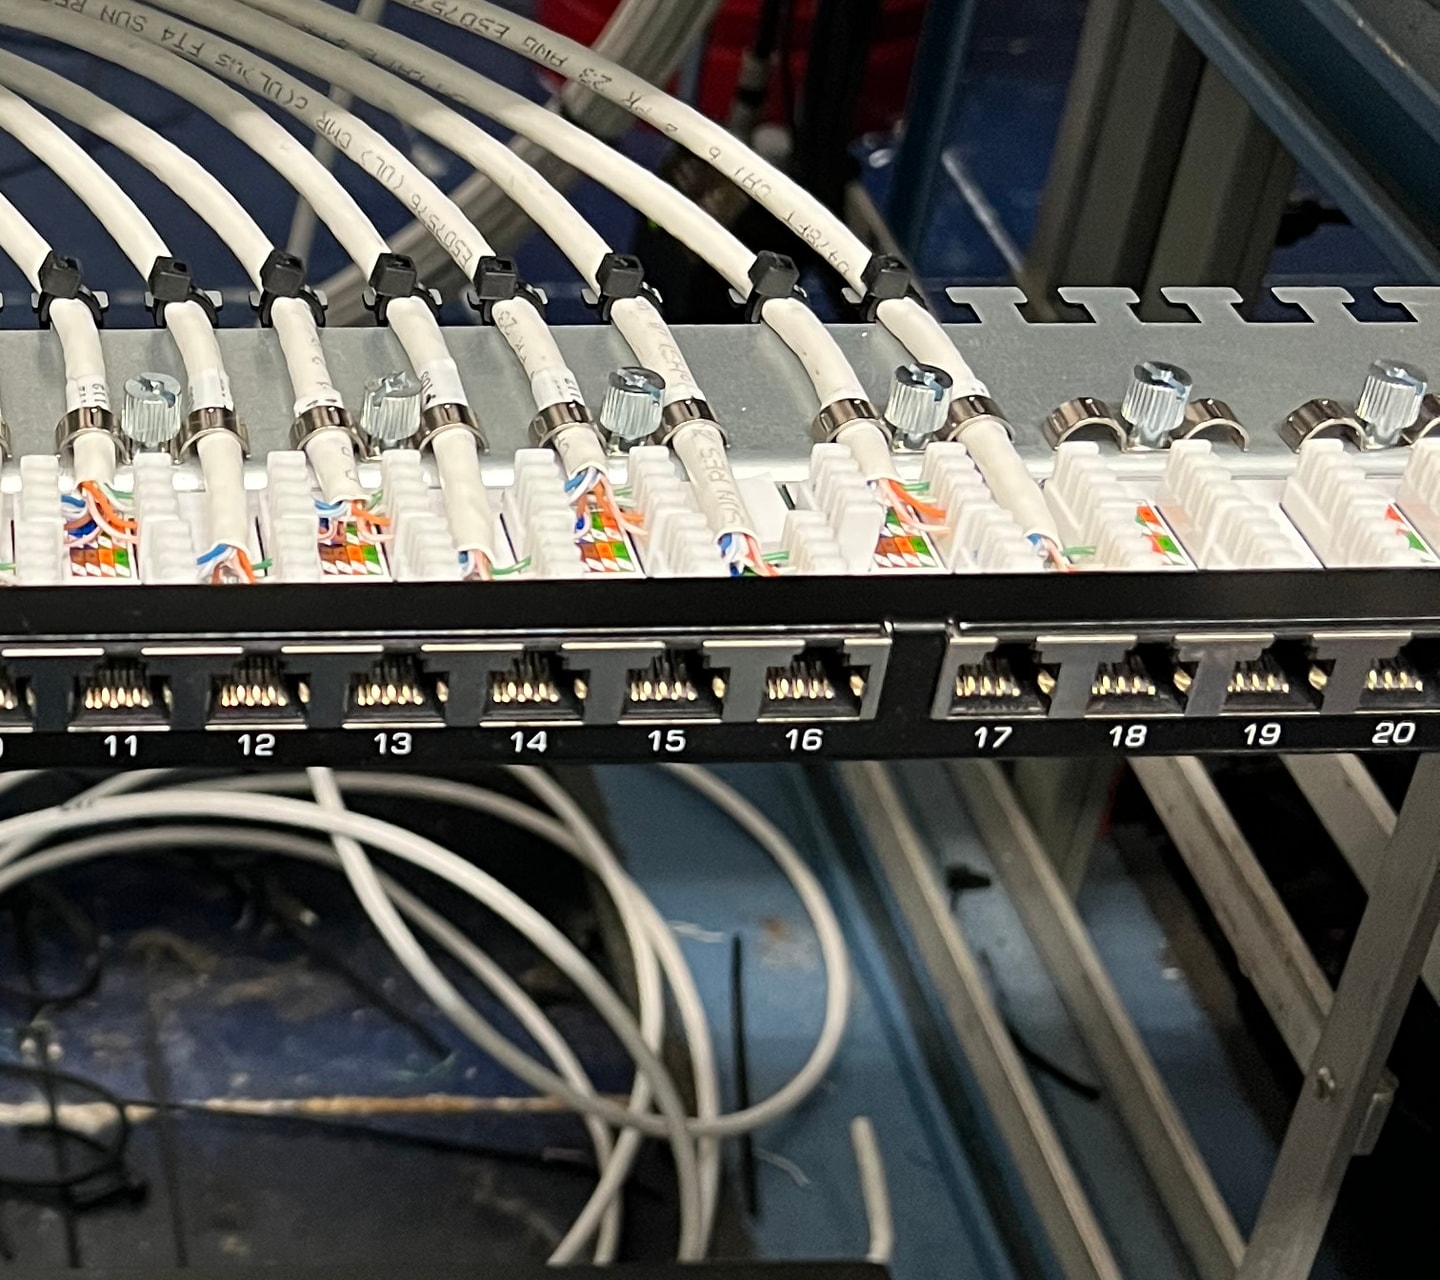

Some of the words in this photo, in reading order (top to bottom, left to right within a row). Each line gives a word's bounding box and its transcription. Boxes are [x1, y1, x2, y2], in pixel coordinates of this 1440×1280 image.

[97, 3, 149, 35] SUN
[161, 25, 207, 60] FT4
[314, 110, 353, 151] CMR
[357, 148, 408, 195] (UL)
[698, 446, 724, 483] RES
[373, 732, 412, 755] 13
[510, 730, 547, 753] 14
[647, 729, 686, 752] 15
[785, 728, 823, 751] 16
[974, 726, 1013, 748] 17
[1109, 724, 1148, 747] 18
[1244, 723, 1282, 746] 19
[1371, 721, 1416, 744] 20
[104, 734, 137, 757] 11
[237, 733, 276, 756] 12
